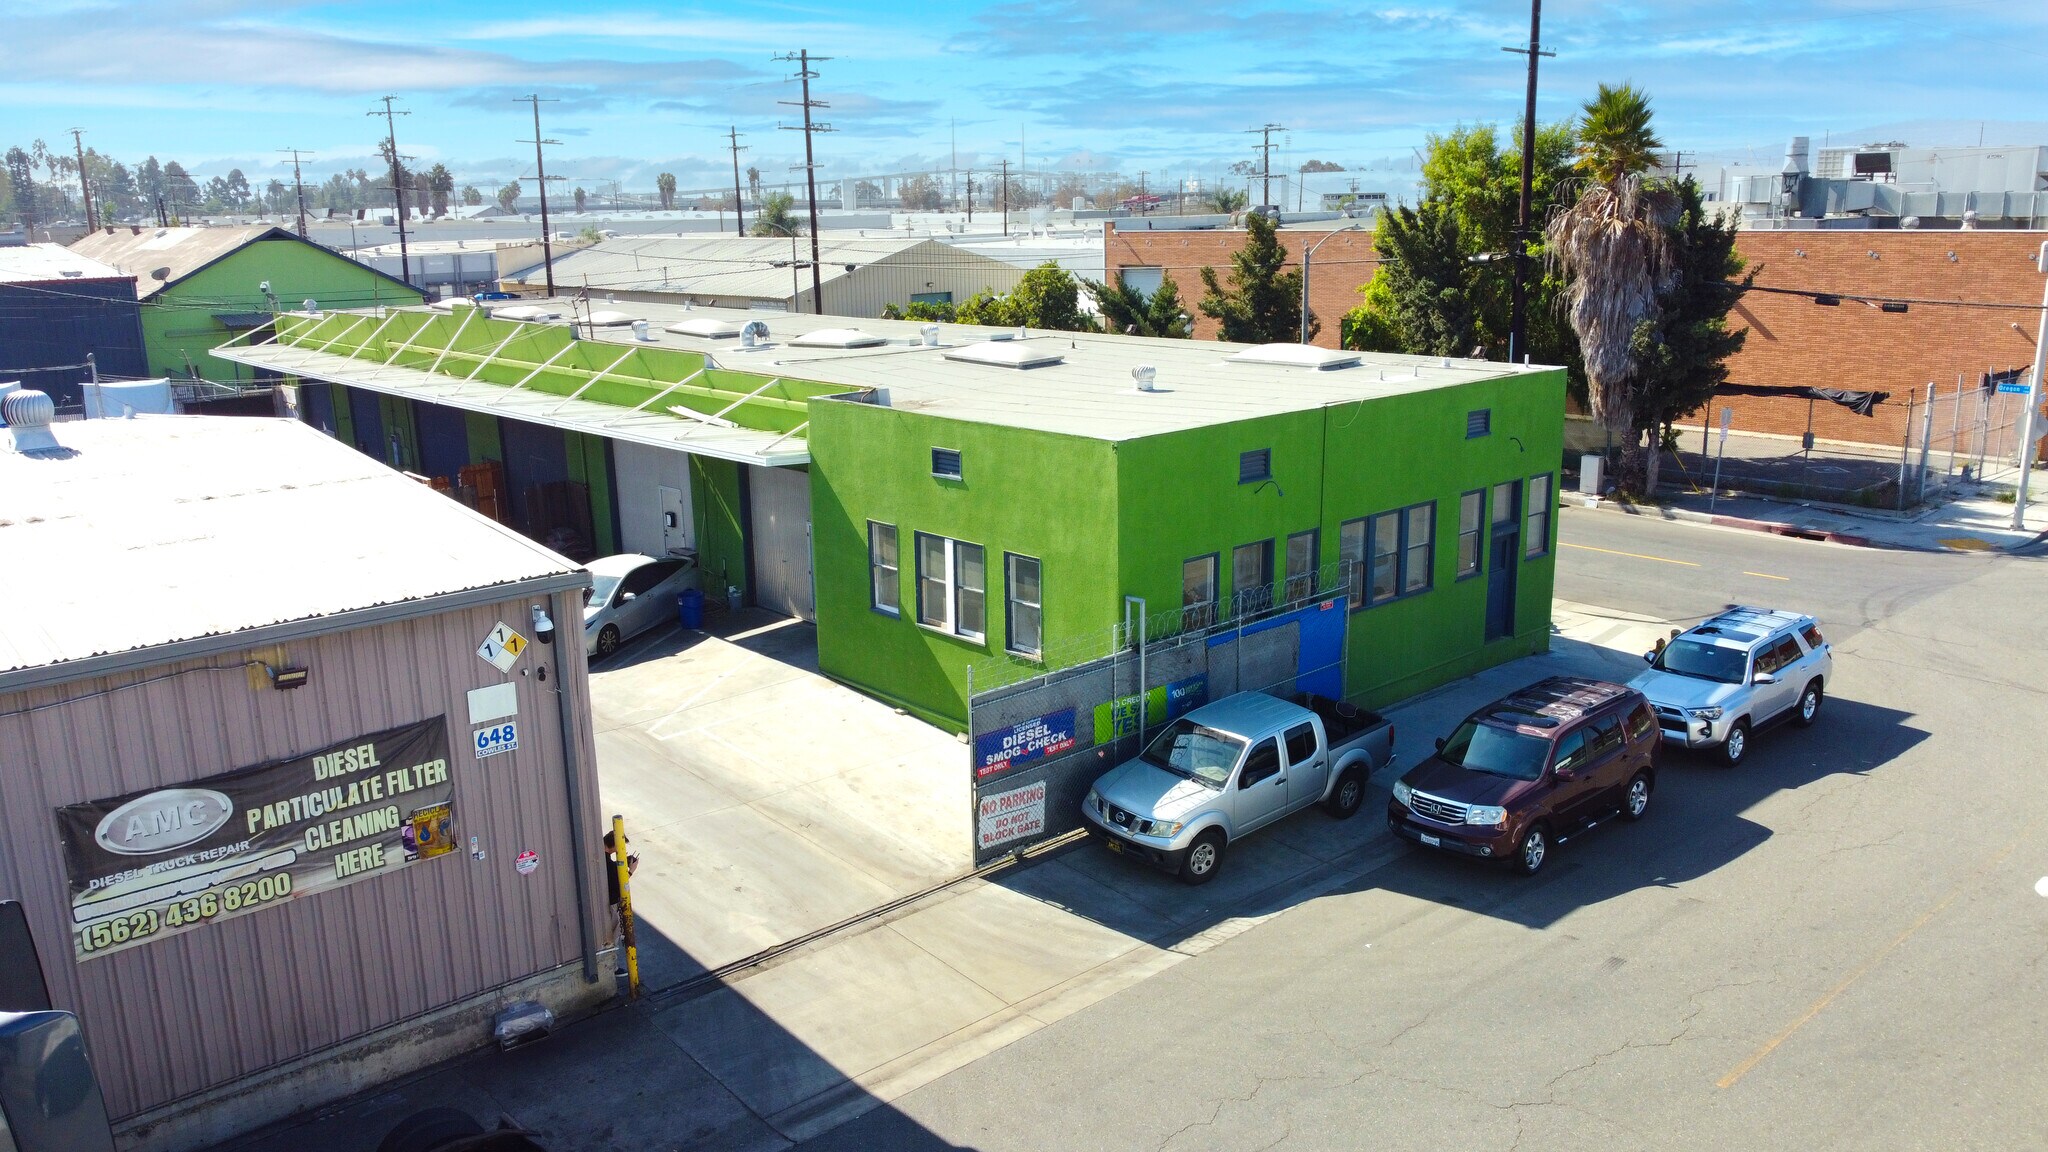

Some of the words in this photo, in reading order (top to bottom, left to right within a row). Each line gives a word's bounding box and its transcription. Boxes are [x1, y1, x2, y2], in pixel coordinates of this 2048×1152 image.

[484, 643, 493, 657] 1
[510, 638, 518, 652] 1
[496, 628, 504, 642] 1
[477, 725, 515, 749] 648
[1003, 724, 1052, 749] DIESEL
[1013, 721, 1041, 733] LICENSED
[477, 744, 506, 758] COWLES
[986, 745, 1021, 765] SMOG
[1027, 730, 1067, 751] CHECK
[1046, 744, 1059, 753] TEST
[1059, 739, 1073, 750] ONLY
[313, 743, 380, 781] DIESEL
[979, 766, 993, 776] TEST
[993, 760, 1008, 771] ONLY
[246, 775, 384, 834] PARTICULATE
[386, 758, 448, 796] FILTER
[981, 799, 997, 817] NO
[1000, 786, 1044, 812] PARKING
[125, 800, 208, 842] AMC
[304, 805, 400, 851] CLEANING
[983, 826, 1015, 843] BLOCK
[1017, 819, 1041, 833] GATE
[996, 817, 1009, 829] DO
[1010, 811, 1030, 824] NOT
[88, 866, 144, 890] DIESEL
[148, 853, 197, 876] TRUCK
[201, 841, 251, 862] REPAIR
[334, 843, 386, 879] HERE
[81, 909, 159, 952] (562)
[165, 892, 219, 928] 436
[223, 872, 292, 911] 8200
